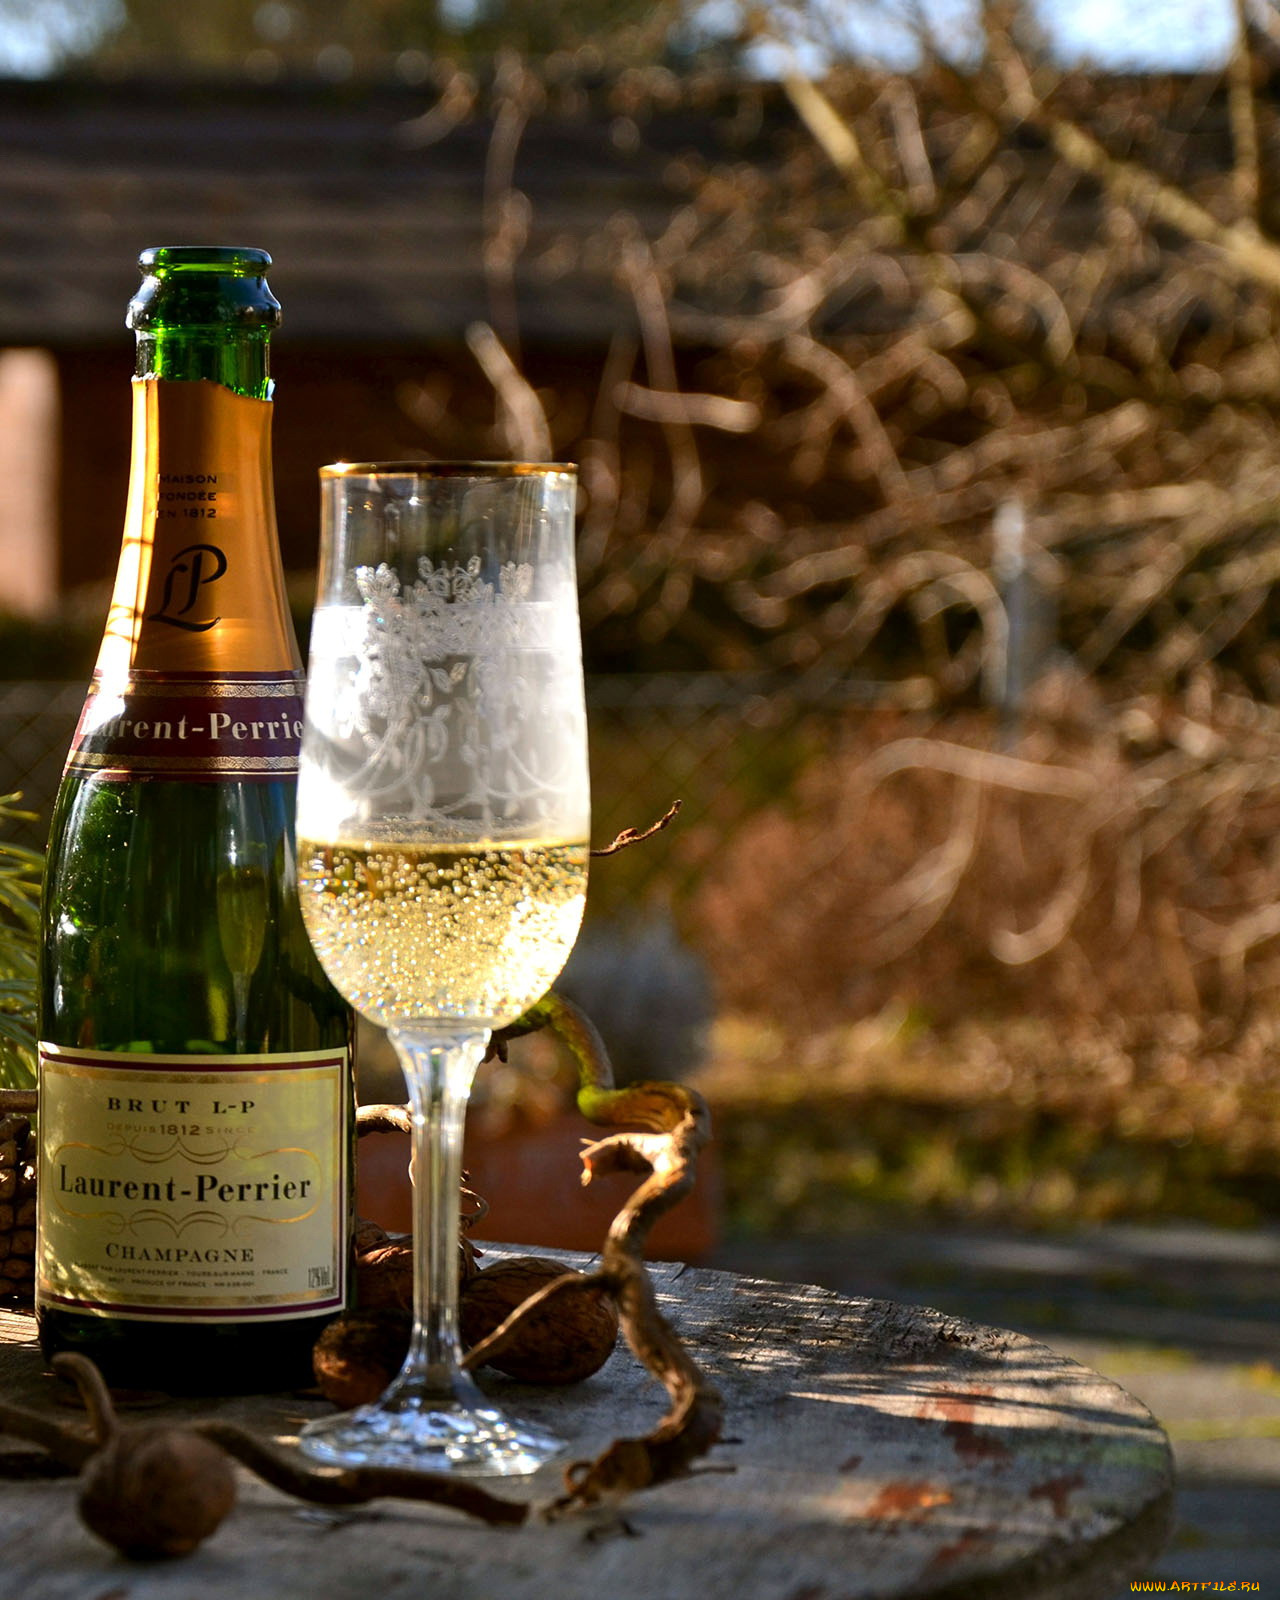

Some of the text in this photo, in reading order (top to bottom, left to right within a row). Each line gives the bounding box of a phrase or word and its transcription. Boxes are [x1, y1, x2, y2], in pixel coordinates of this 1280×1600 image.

[158, 474, 217, 484] MAISON
[183, 508, 217, 518] 1812
[107, 1097, 255, 1114] BRUT L-P
[106, 1122, 256, 1136] DEPUIS 1812 SINCE
[59, 1164, 312, 1202] Laurent-Perrier
[105, 1242, 255, 1263] CHAMPAGNE
